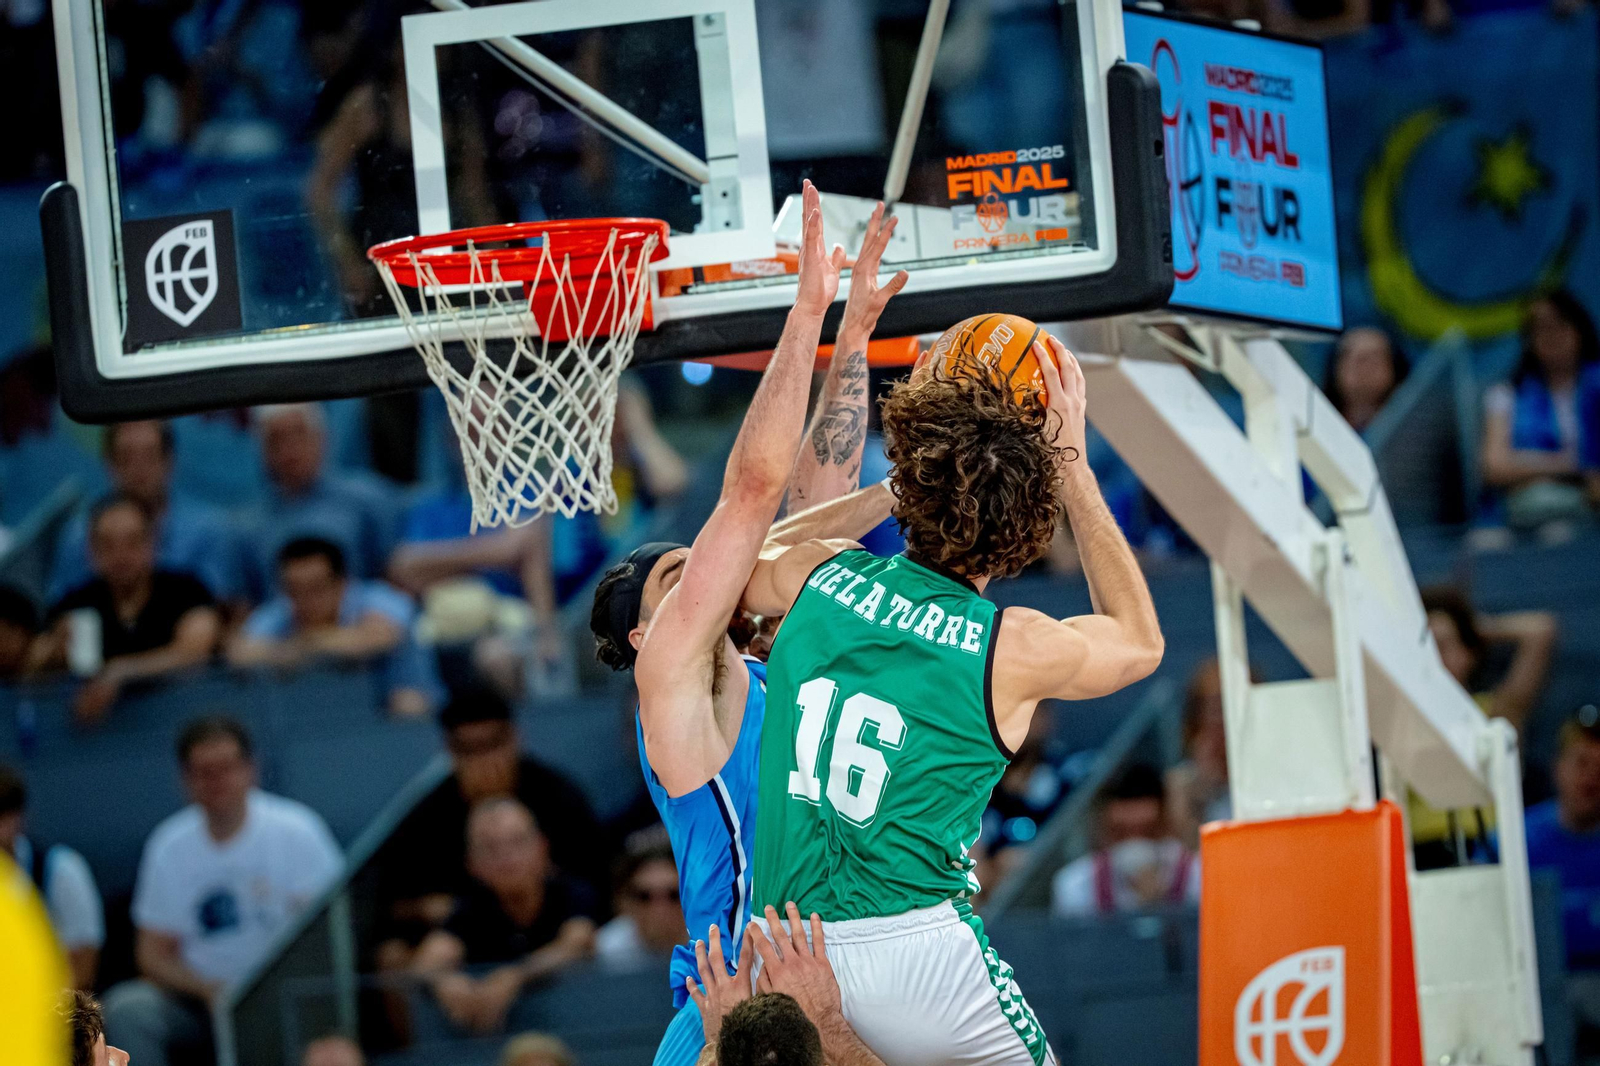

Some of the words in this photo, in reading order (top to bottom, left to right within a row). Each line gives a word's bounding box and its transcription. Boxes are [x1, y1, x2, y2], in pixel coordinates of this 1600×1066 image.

[1208, 100, 1299, 168] FINAL
[947, 163, 1068, 199] FINAL
[185, 227, 207, 239] FEB
[954, 232, 1030, 250] PRIMERA
[977, 323, 1015, 374] EVO
[788, 677, 908, 829] 16
[1300, 957, 1334, 973] FEB
